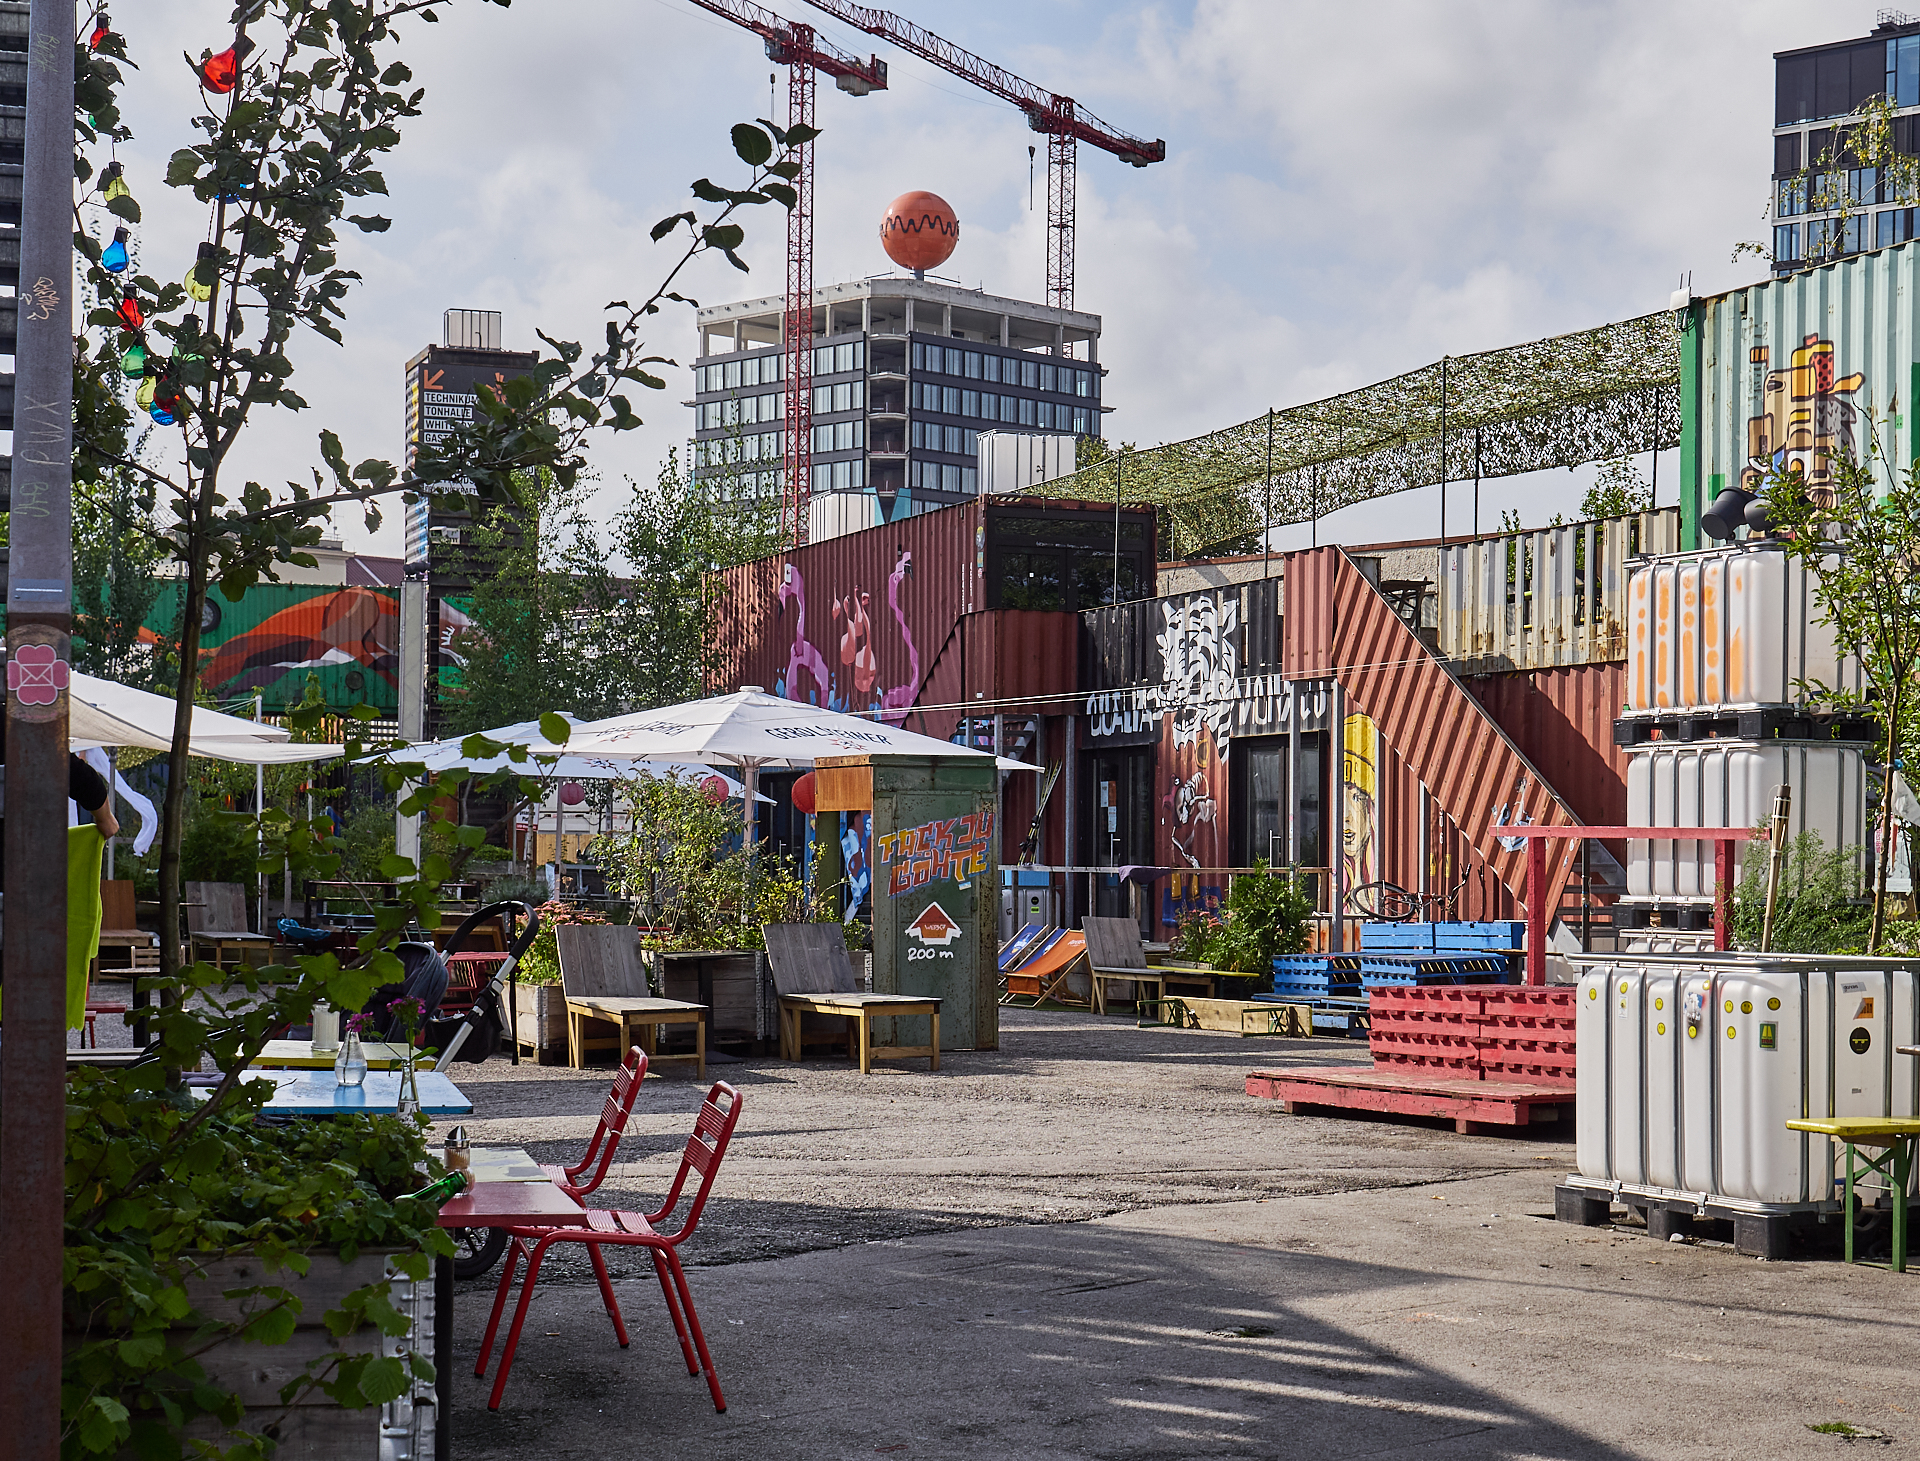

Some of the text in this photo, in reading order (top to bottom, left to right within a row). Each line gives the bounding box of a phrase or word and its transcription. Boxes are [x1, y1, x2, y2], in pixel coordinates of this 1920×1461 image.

[957, 811, 995, 844] JU
[907, 946, 954, 962] 200 m
